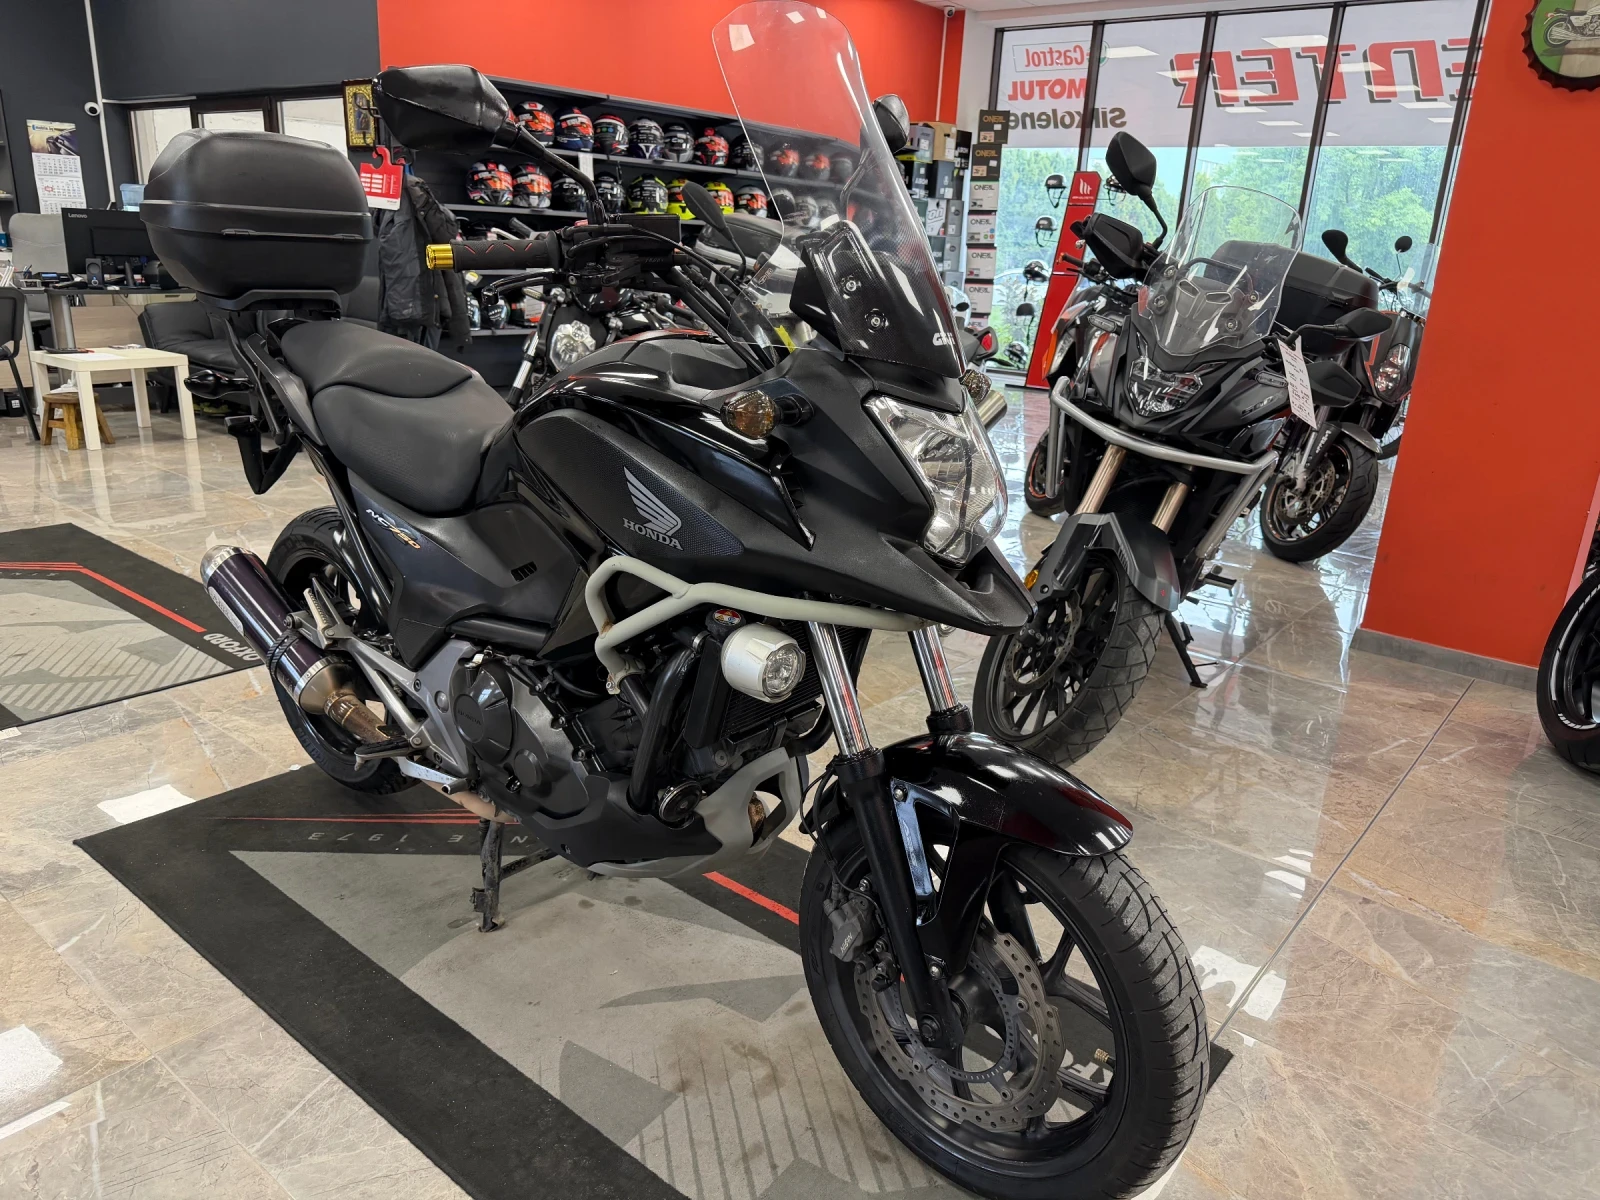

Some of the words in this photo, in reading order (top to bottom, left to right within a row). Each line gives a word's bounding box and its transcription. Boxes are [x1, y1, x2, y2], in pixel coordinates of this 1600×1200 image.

[622, 517, 684, 551] HONDA
[203, 632, 260, 662] OXFORD
[307, 831, 410, 843] 1973
